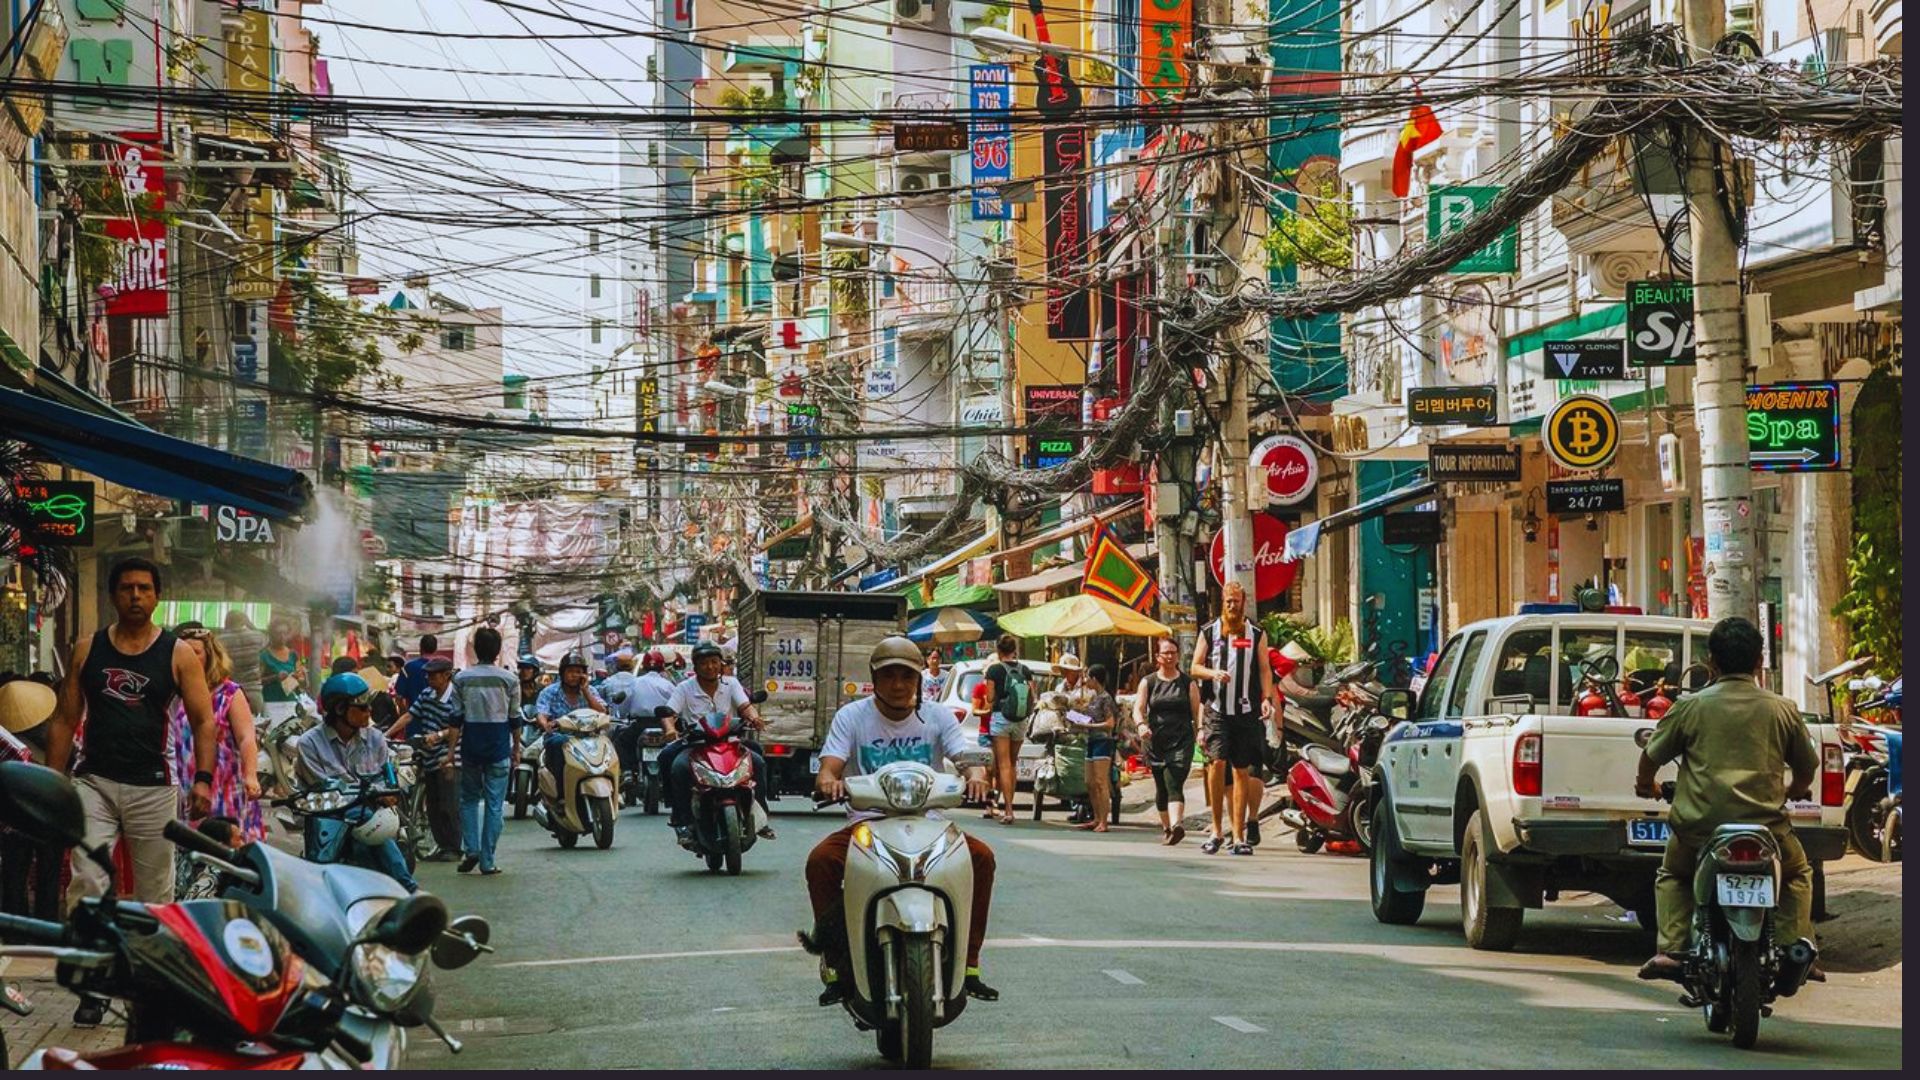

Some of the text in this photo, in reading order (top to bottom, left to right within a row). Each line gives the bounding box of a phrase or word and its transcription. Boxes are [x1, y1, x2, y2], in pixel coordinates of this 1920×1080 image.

[974, 69, 1007, 88] ROOM
[978, 91, 1001, 110] FOR
[974, 136, 1008, 170] 96
[123, 148, 148, 199] &
[1585, 343, 1620, 351] CLOTHING
[1029, 390, 1079, 399] UNIVERSAL
[1746, 411, 1820, 447] Spa
[1040, 441, 1073, 453] PIZZA
[1434, 455, 1516, 472] TOUR INFORMATION
[1568, 496, 1604, 508] 24/7
[216, 505, 276, 543] SPA
[1725, 874, 1764, 890] 52-77
[1726, 891, 1767, 906] 1976
